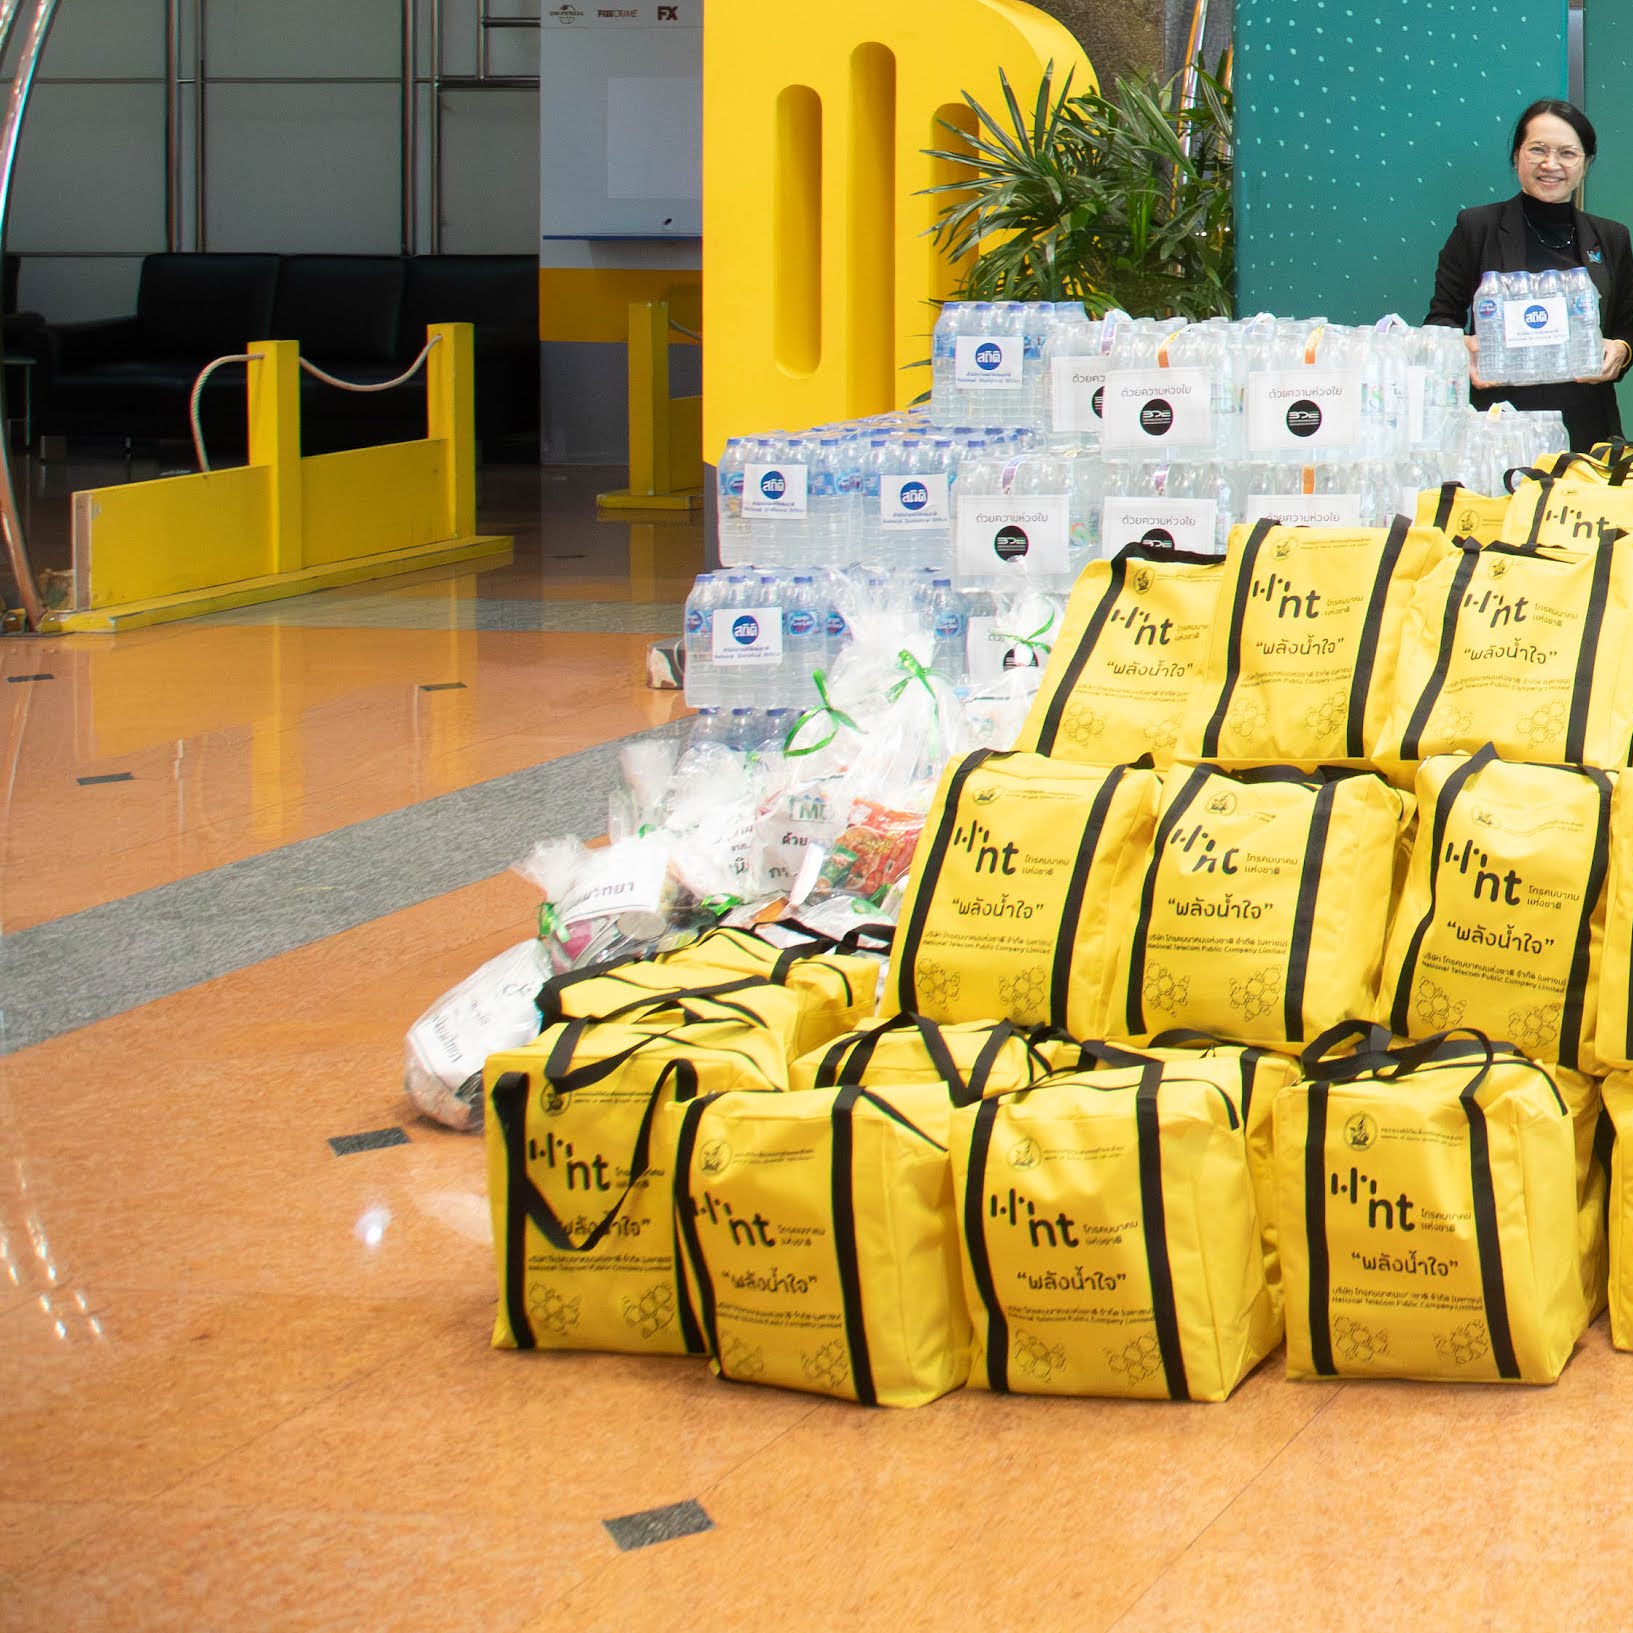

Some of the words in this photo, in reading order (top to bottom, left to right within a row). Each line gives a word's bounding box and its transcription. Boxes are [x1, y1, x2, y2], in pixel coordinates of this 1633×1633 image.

[658, 6, 678, 20] FX
[1573, 512, 1611, 540] nt
[1278, 590, 1320, 618] nt
[1490, 597, 1528, 628] nt
[1134, 618, 1173, 645] nt
[976, 842, 1019, 876] nt
[1192, 848, 1240, 875] nt
[1474, 870, 1522, 906] nt
[566, 1154, 610, 1191] nt
[1369, 1193, 1415, 1232] nt
[728, 1214, 776, 1247] nt
[1028, 1212, 1080, 1248] nt
